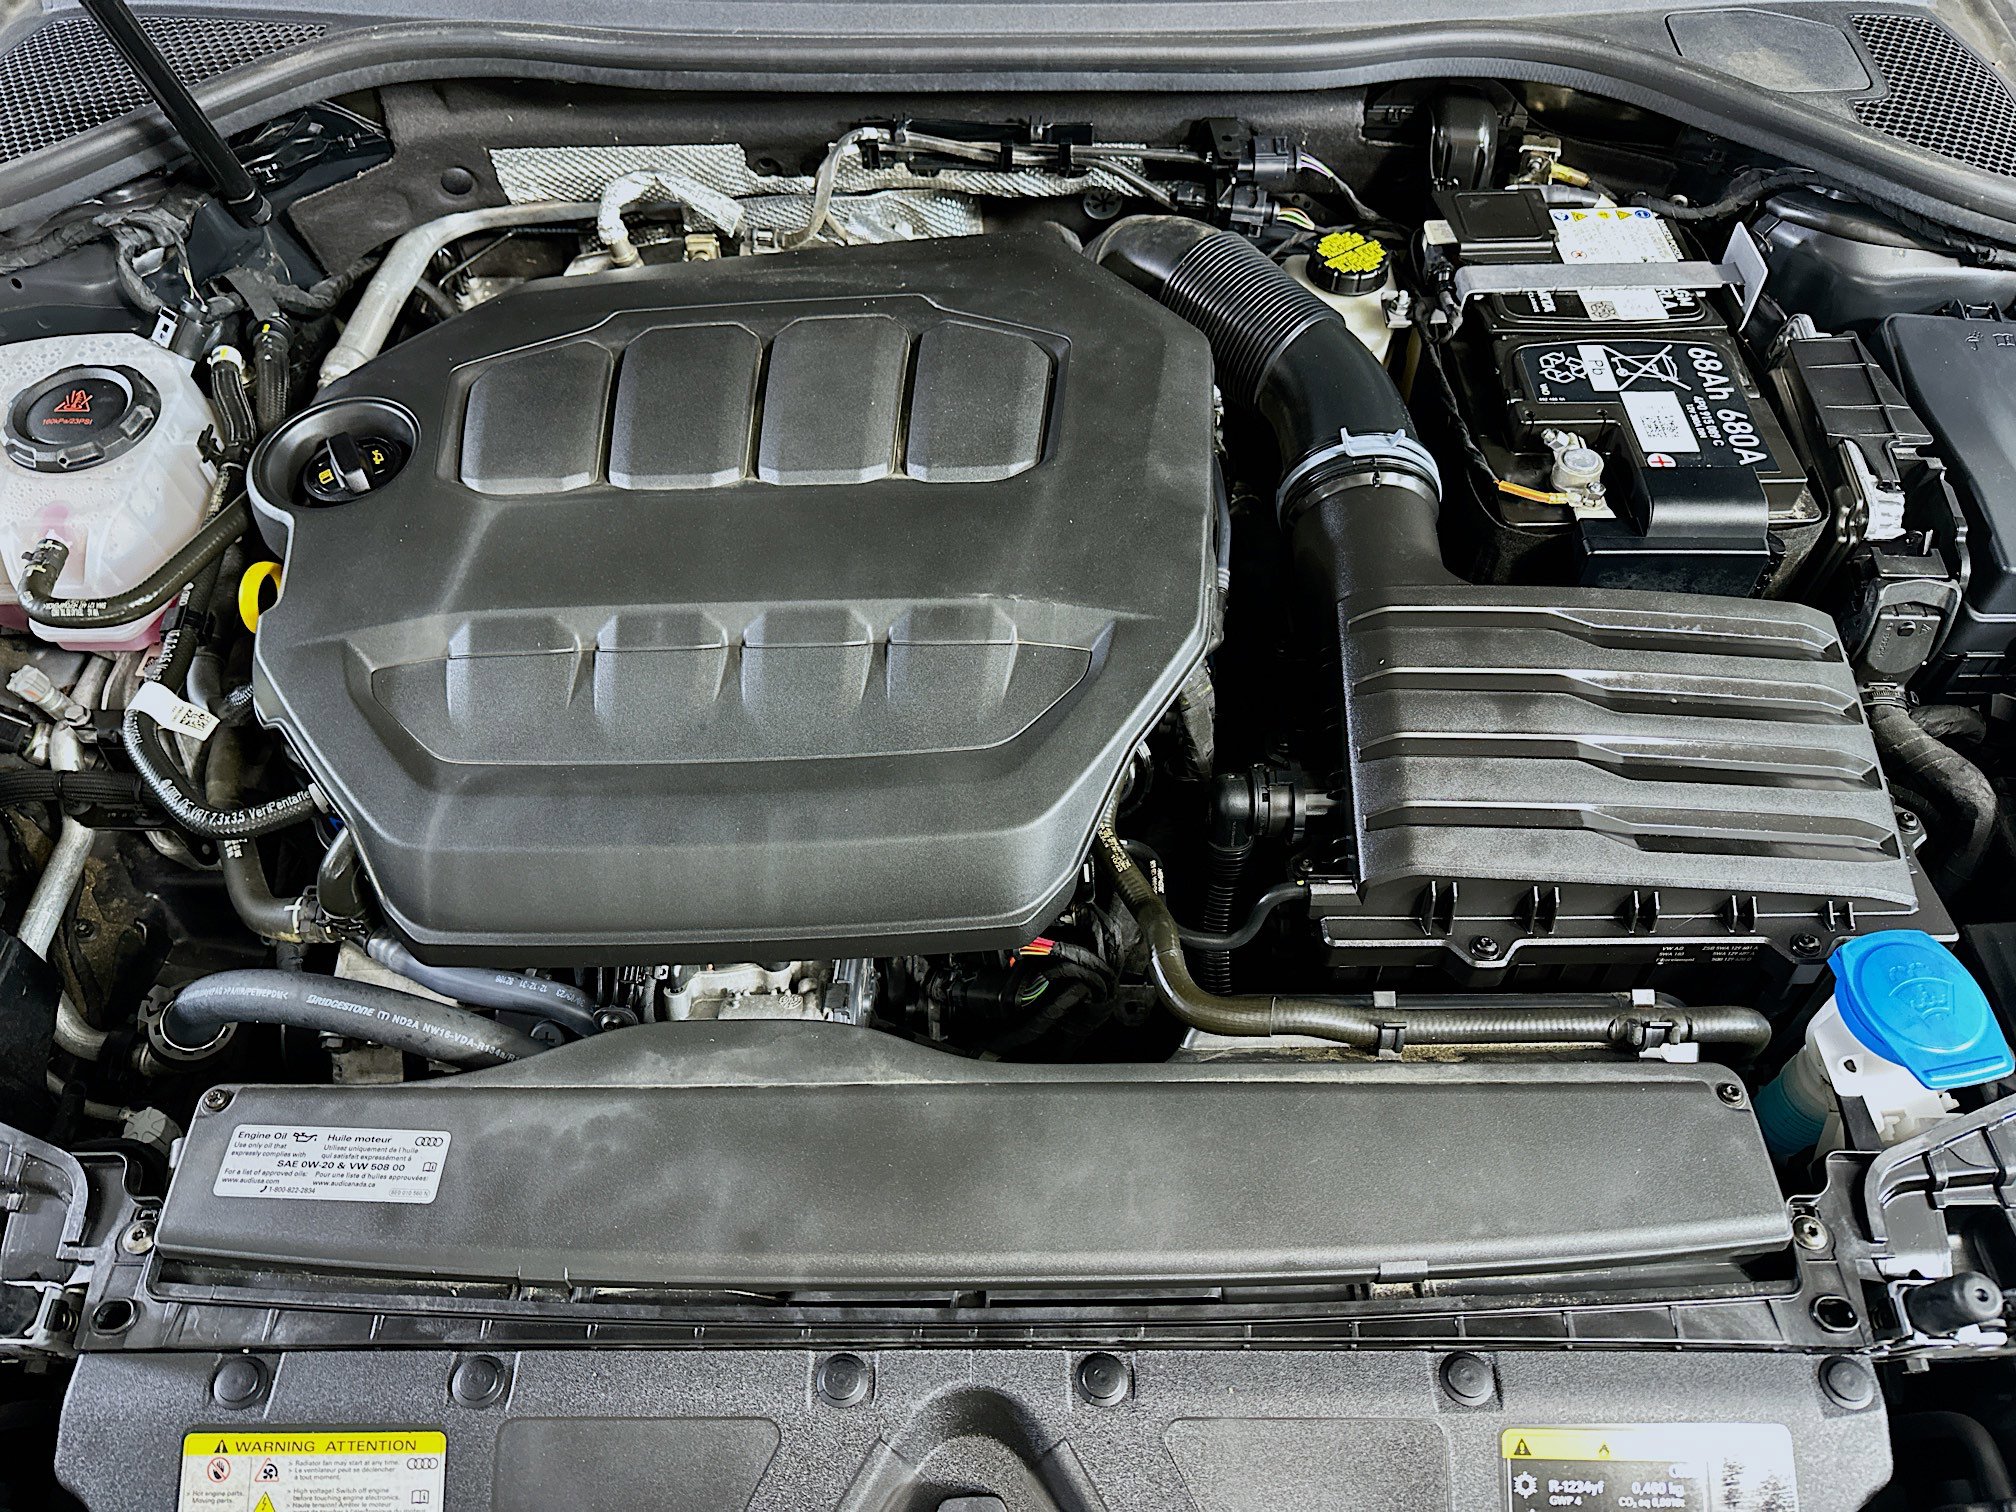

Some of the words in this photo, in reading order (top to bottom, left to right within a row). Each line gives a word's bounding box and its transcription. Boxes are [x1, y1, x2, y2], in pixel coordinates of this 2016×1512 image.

[1655, 288, 1678, 310] RLA
[1671, 288, 1696, 307] GM
[1588, 359, 1605, 376] Pb
[1687, 347, 1735, 400] 68Ah
[1716, 408, 1768, 466] 680A
[1699, 411, 1715, 425] 915
[1712, 439, 1725, 447] C
[249, 790, 311, 820] VeriPentafle
[306, 994, 375, 1017] BRIDGESTONE
[391, 1014, 419, 1030] ND2A
[422, 1022, 520, 1063] NW16-VDA-R134a/R
[238, 1131, 271, 1140] Engine
[274, 1132, 288, 1140] Oil
[354, 1135, 392, 1143] moteur
[277, 1160, 298, 1168] SAE
[301, 1161, 335, 1169] 0W-20
[350, 1162, 369, 1170] VW
[370, 1163, 390, 1171] 508
[392, 1163, 406, 1171] 00
[360, 1154, 406, 1162] expressément
[312, 1180, 376, 1188] www.audicanada.ca
[236, 1441, 315, 1452] WARNING
[325, 1440, 417, 1452] ATTENTION
[1548, 1479, 1605, 1496] R-1234yf
[1668, 1481, 1685, 1497] kg
[1574, 1496, 1583, 1506] 4
